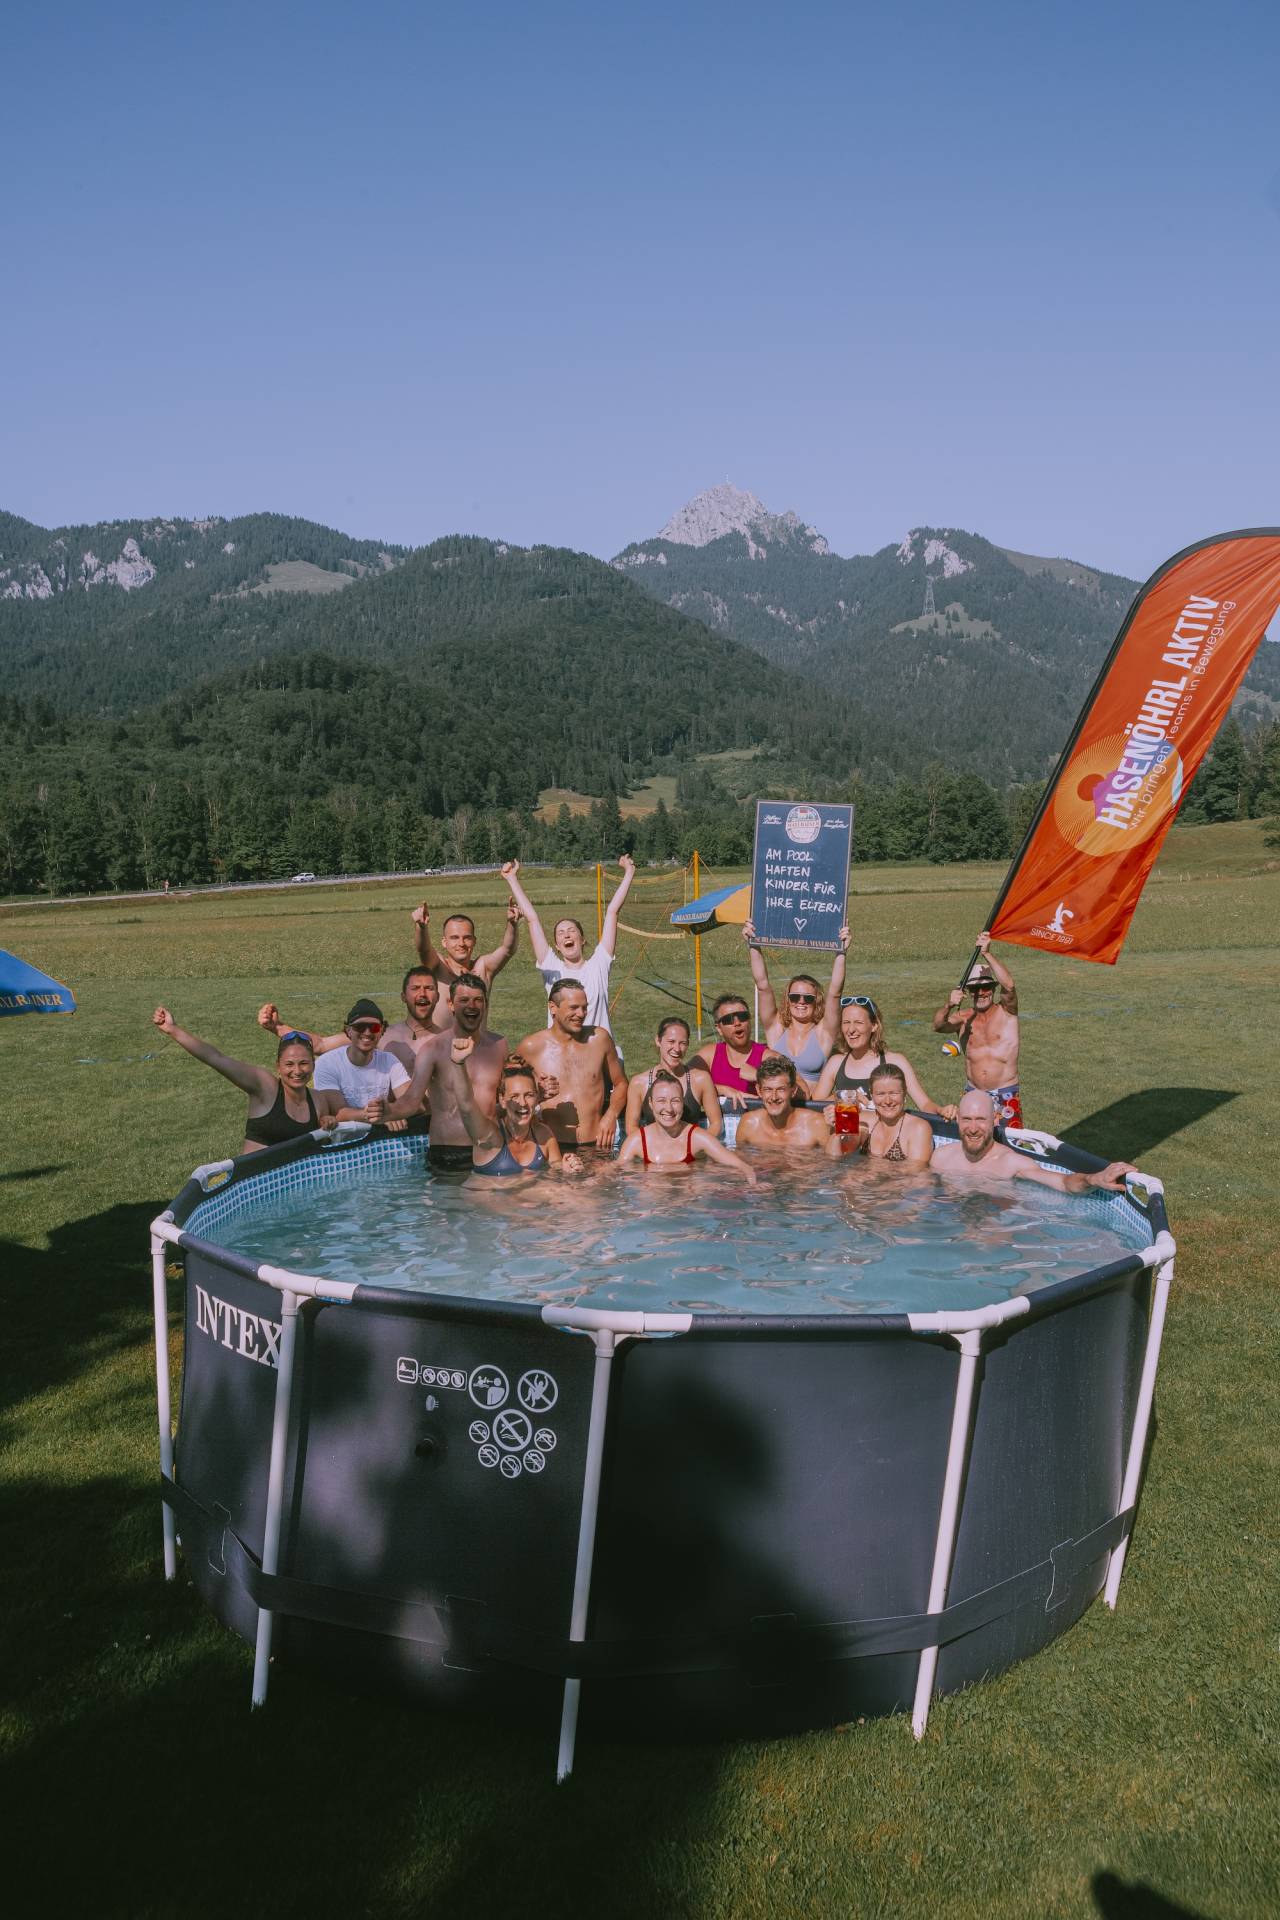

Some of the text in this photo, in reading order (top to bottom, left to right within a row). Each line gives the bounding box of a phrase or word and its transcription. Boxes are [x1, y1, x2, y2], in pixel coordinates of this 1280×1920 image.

[1192, 600, 1238, 675] Bewegung
[1185, 679, 1201, 692] in
[1096, 595, 1220, 831] HASENÖHRL AKTIV
[1164, 694, 1194, 742] Teams
[1140, 745, 1173, 806] bringen
[765, 848, 814, 862] AM POOL
[765, 864, 811, 877] HAFTEN
[765, 878, 837, 895] KINDER FÜR
[766, 897, 842, 913] IHRE ELTERN
[1030, 927, 1056, 941] SINCE
[195, 1284, 283, 1370] INTEX
